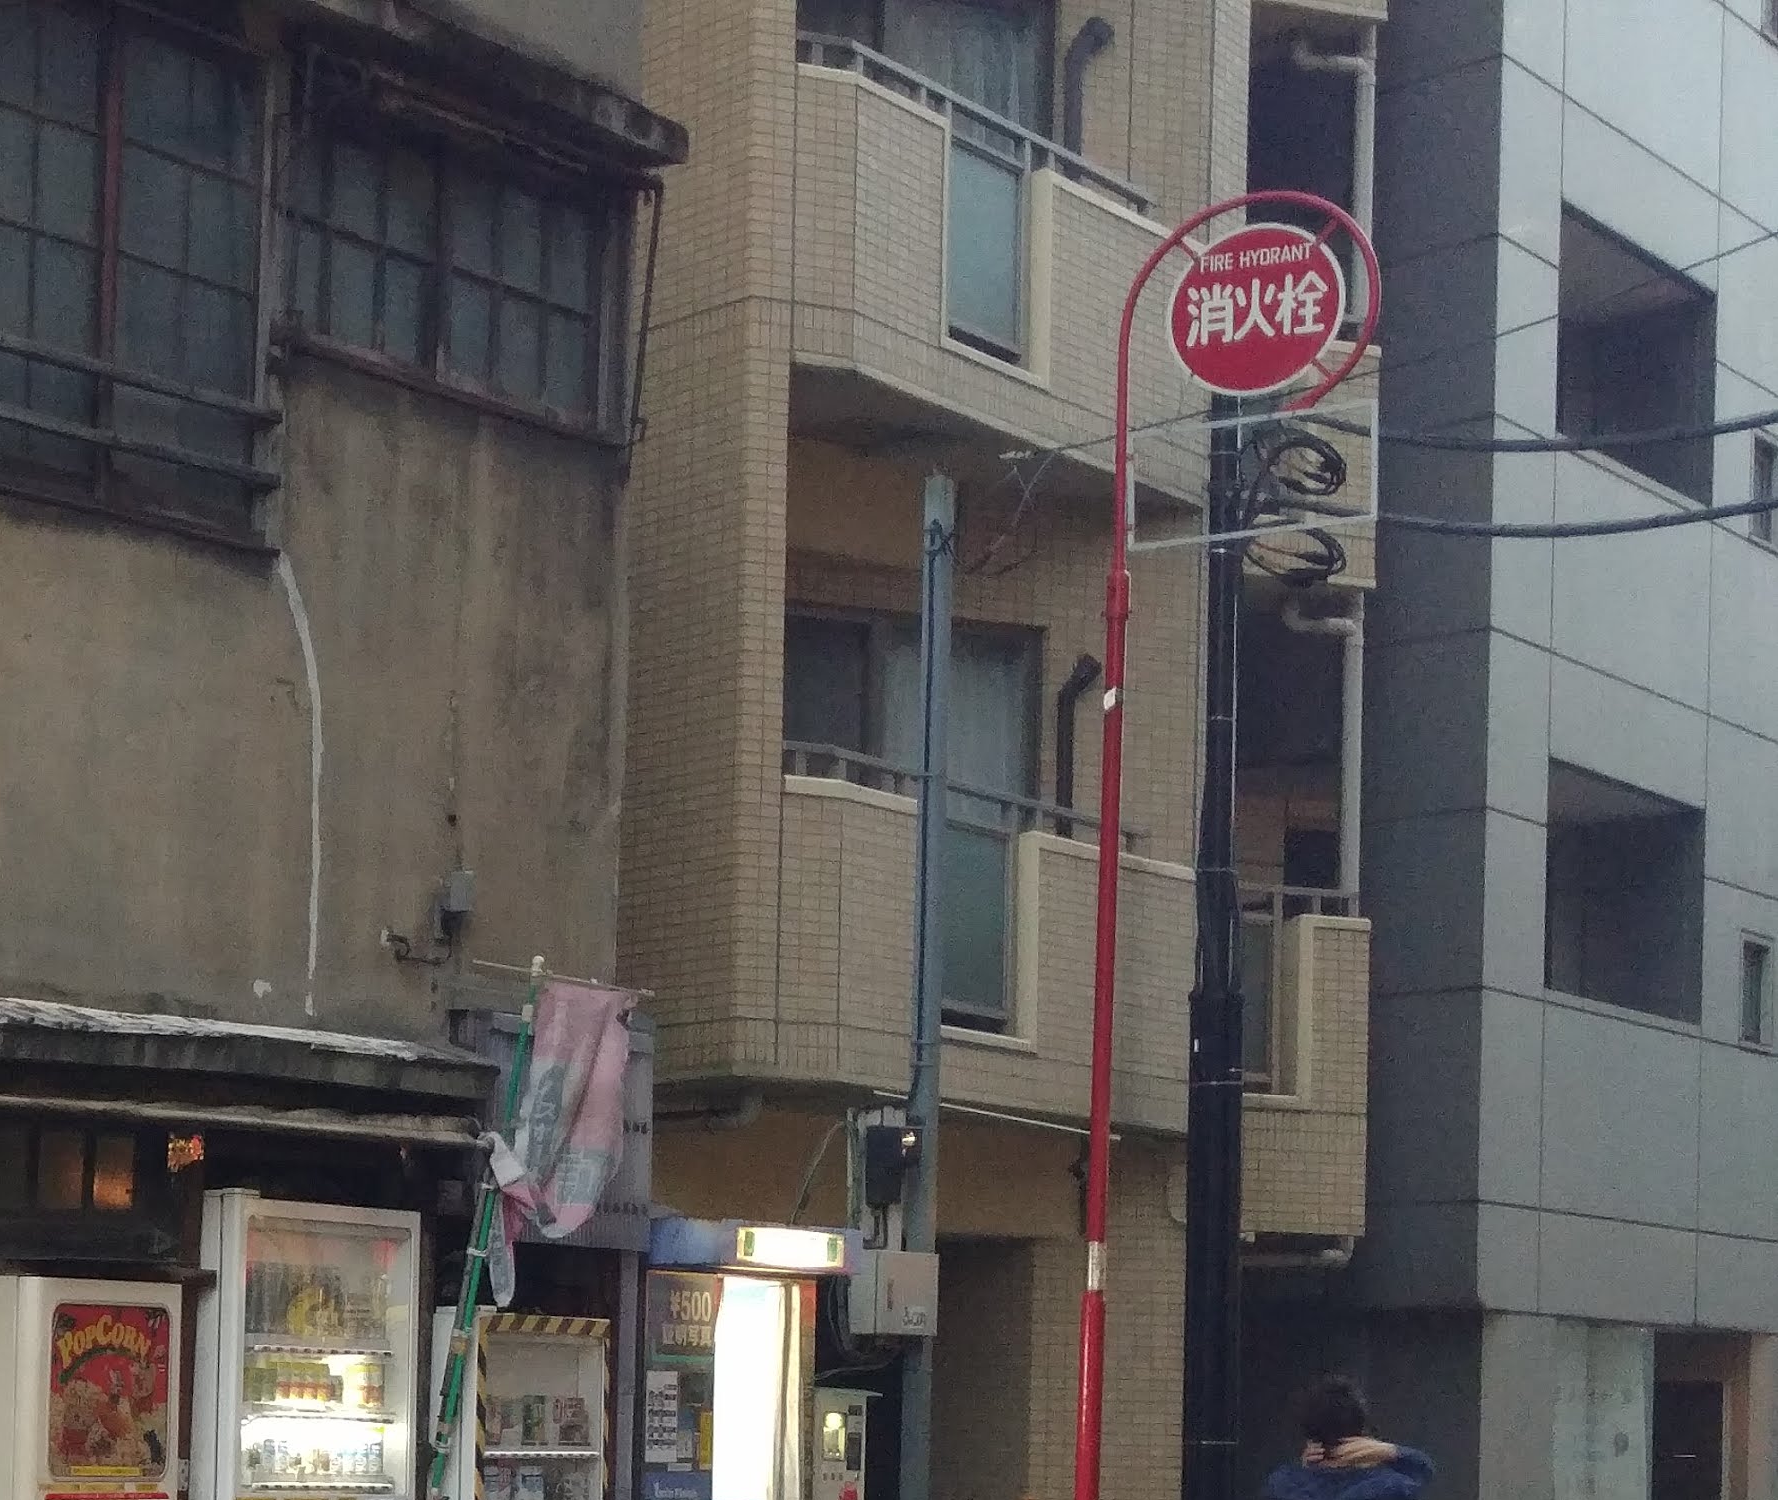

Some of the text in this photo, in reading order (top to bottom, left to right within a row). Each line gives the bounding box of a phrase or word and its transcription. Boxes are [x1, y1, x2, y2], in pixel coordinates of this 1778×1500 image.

[1199, 242, 1313, 274] FIRE HYDRANT
[1186, 270, 1329, 348] 消火栓
[670, 1290, 712, 1323] ¥500
